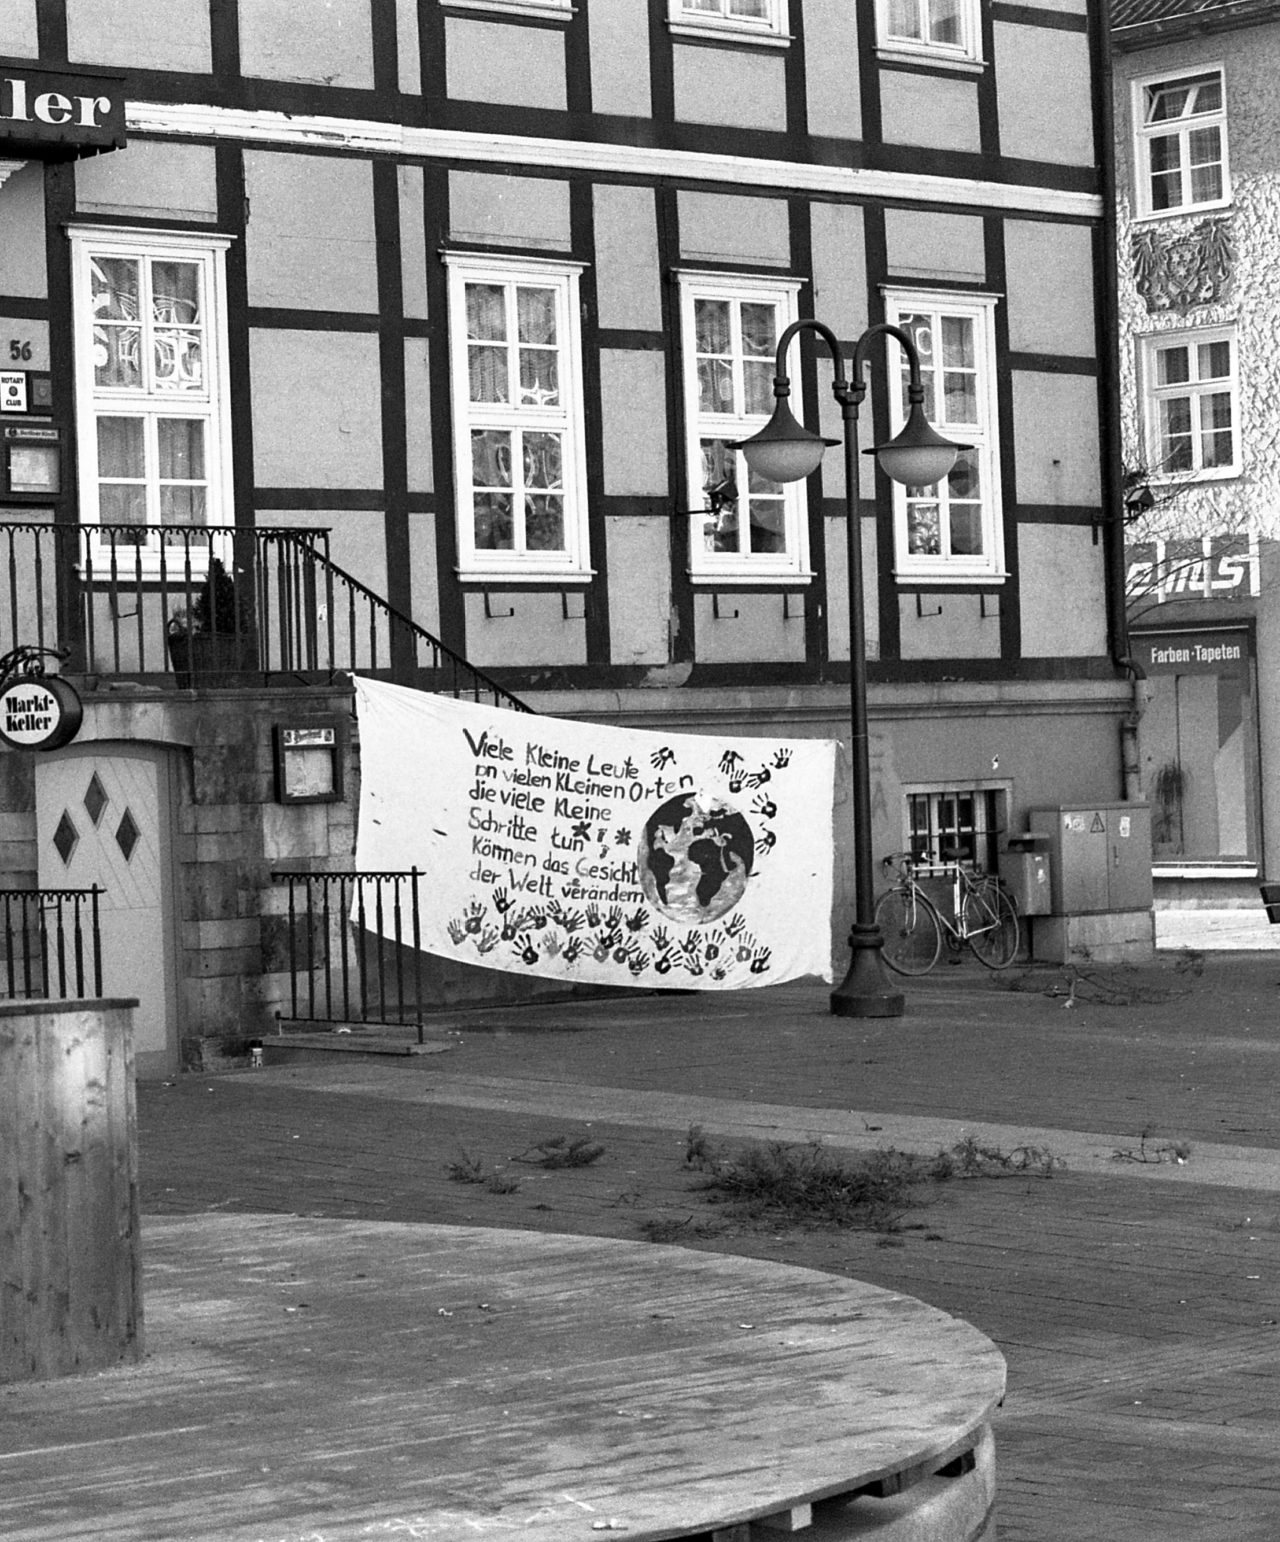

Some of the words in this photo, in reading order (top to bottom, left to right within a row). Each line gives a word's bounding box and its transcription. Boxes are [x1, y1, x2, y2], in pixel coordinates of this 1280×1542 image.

[9, 339, 32, 361] 56
[1, 376, 24, 385] ROTARY
[5, 399, 22, 407] CLUB
[1151, 646, 1190, 664] Farben
[1194, 643, 1241, 664] Tapeten
[5, 694, 54, 714] Markt-
[5, 714, 52, 732] Keller
[462, 728, 514, 761] Viele
[587, 754, 639, 779] Leute
[468, 780, 496, 802] die
[500, 788, 545, 812] viele
[502, 768, 551, 789] vielen
[629, 775, 693, 802] Orten
[468, 807, 537, 842] Schritte
[551, 826, 584, 852] tun
[469, 859, 502, 884] der
[509, 868, 554, 898] Welt
[542, 851, 570, 875] das
[576, 857, 638, 885] Gesicht
